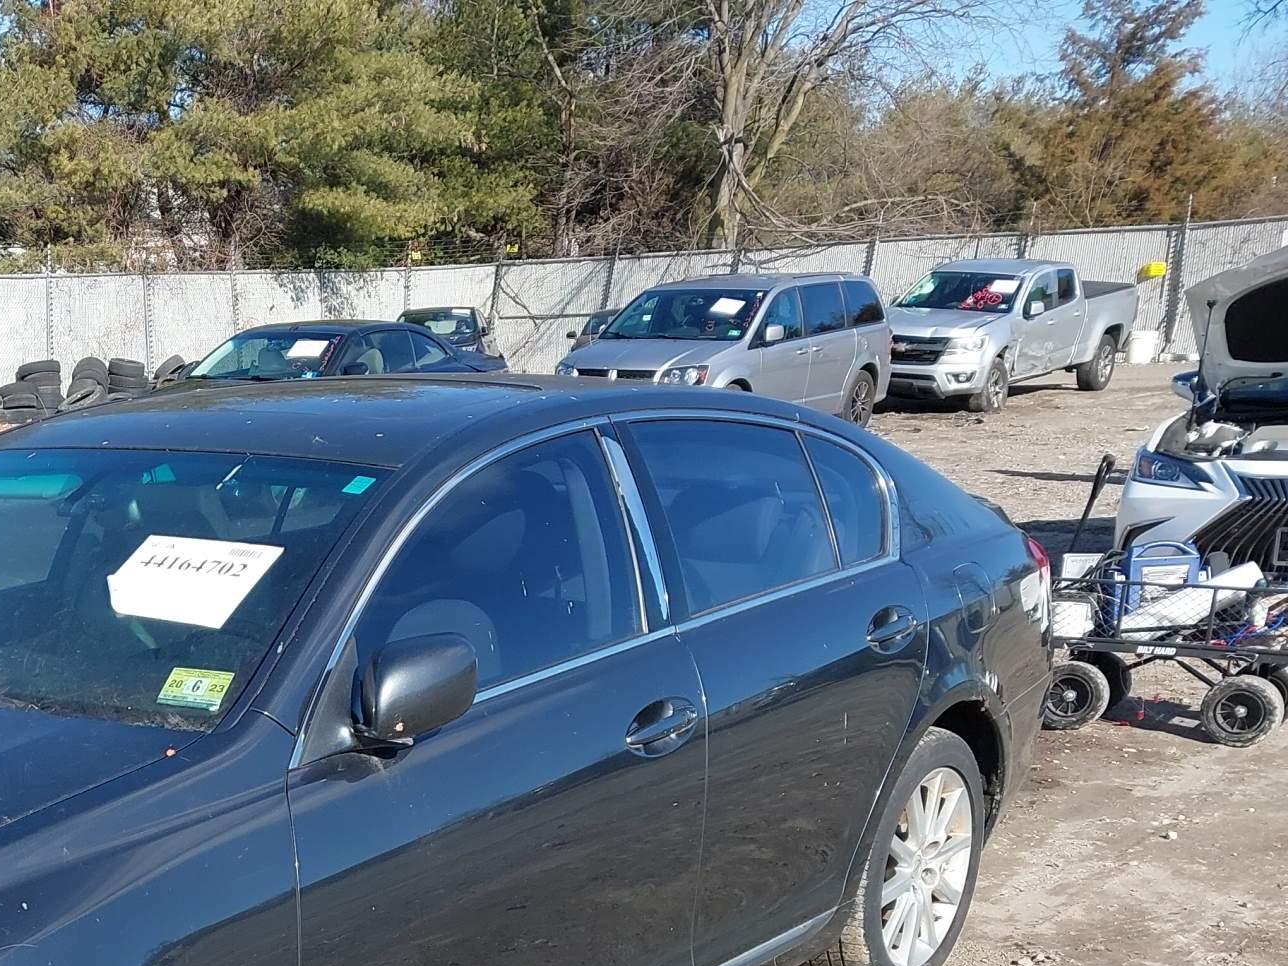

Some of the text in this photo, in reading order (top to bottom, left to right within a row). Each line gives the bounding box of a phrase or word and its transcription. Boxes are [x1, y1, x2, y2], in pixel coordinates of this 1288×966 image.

[140, 554, 248, 577] 44164702
[168, 680, 184, 689] 20
[208, 684, 225, 693] 23
